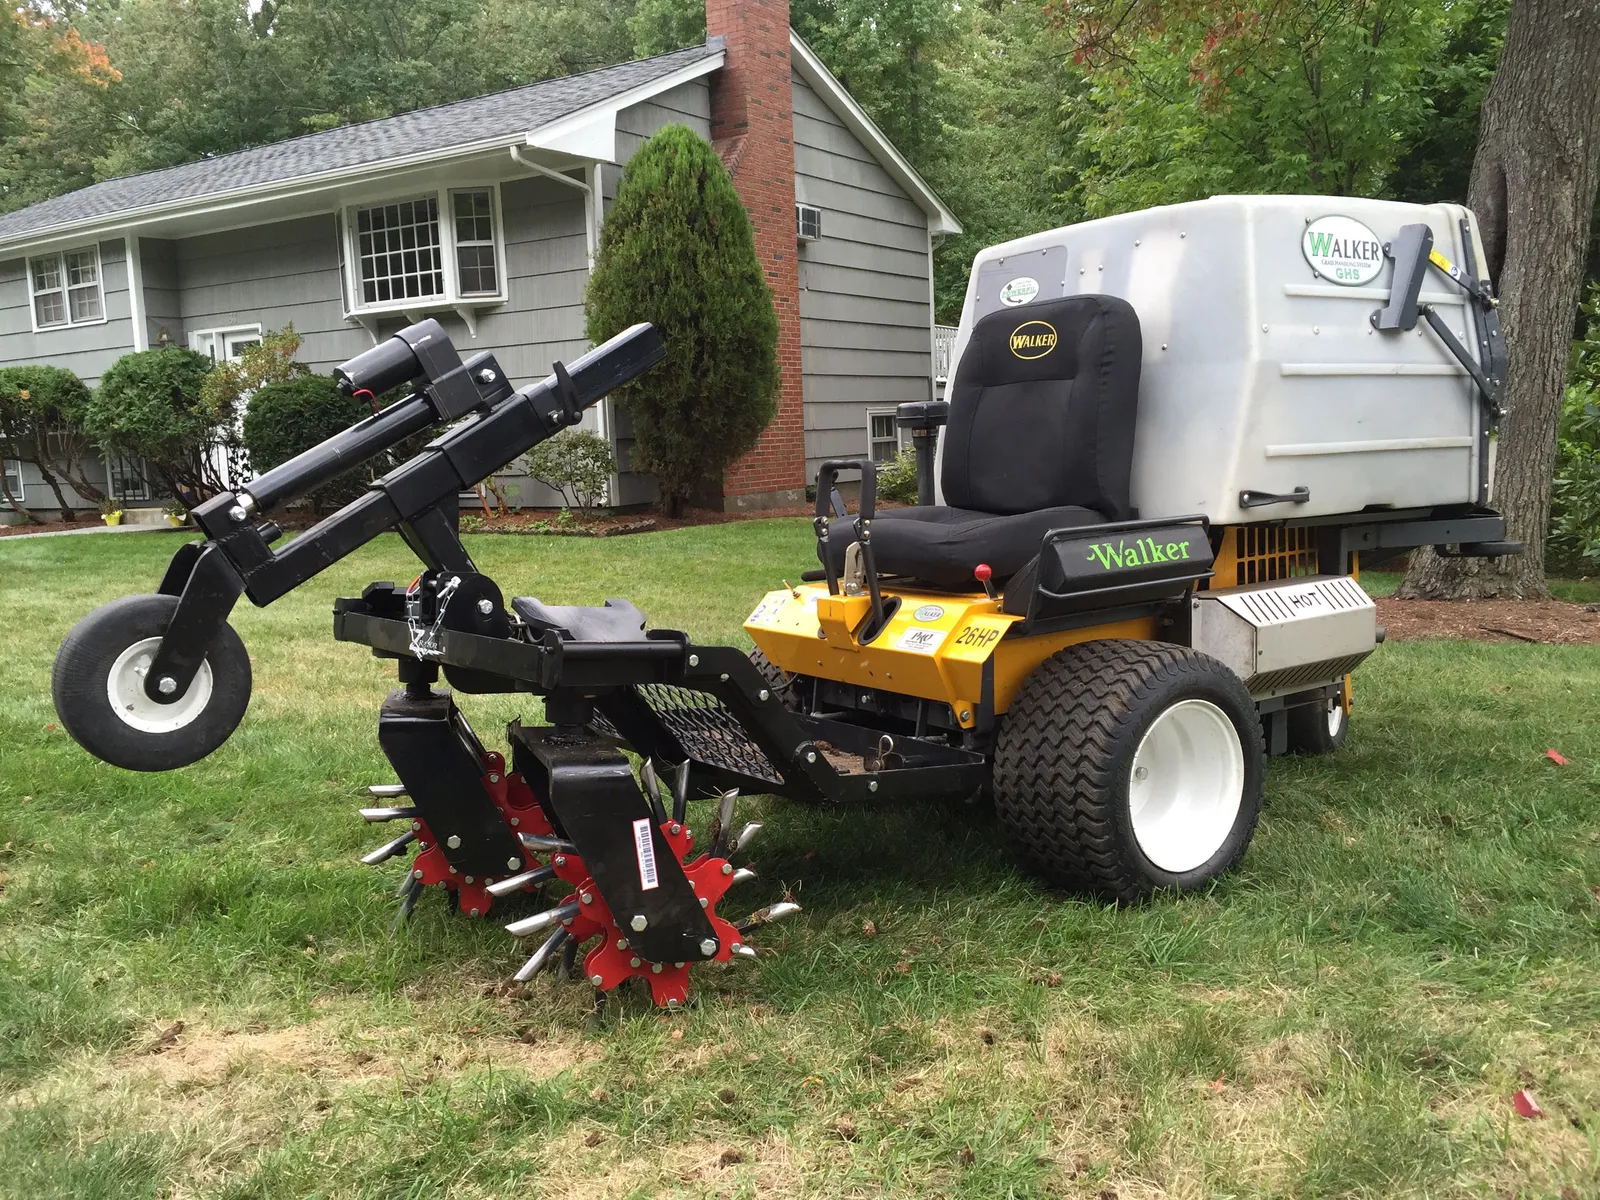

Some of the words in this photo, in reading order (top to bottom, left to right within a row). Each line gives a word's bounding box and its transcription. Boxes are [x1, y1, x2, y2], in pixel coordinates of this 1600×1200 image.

[1308, 231, 1380, 261] WALKER
[1335, 267, 1360, 280] GHS
[1012, 333, 1056, 350] WALKER
[1087, 537, 1190, 570] Walker
[1288, 591, 1322, 609] HOT
[955, 626, 999, 647] 26HP
